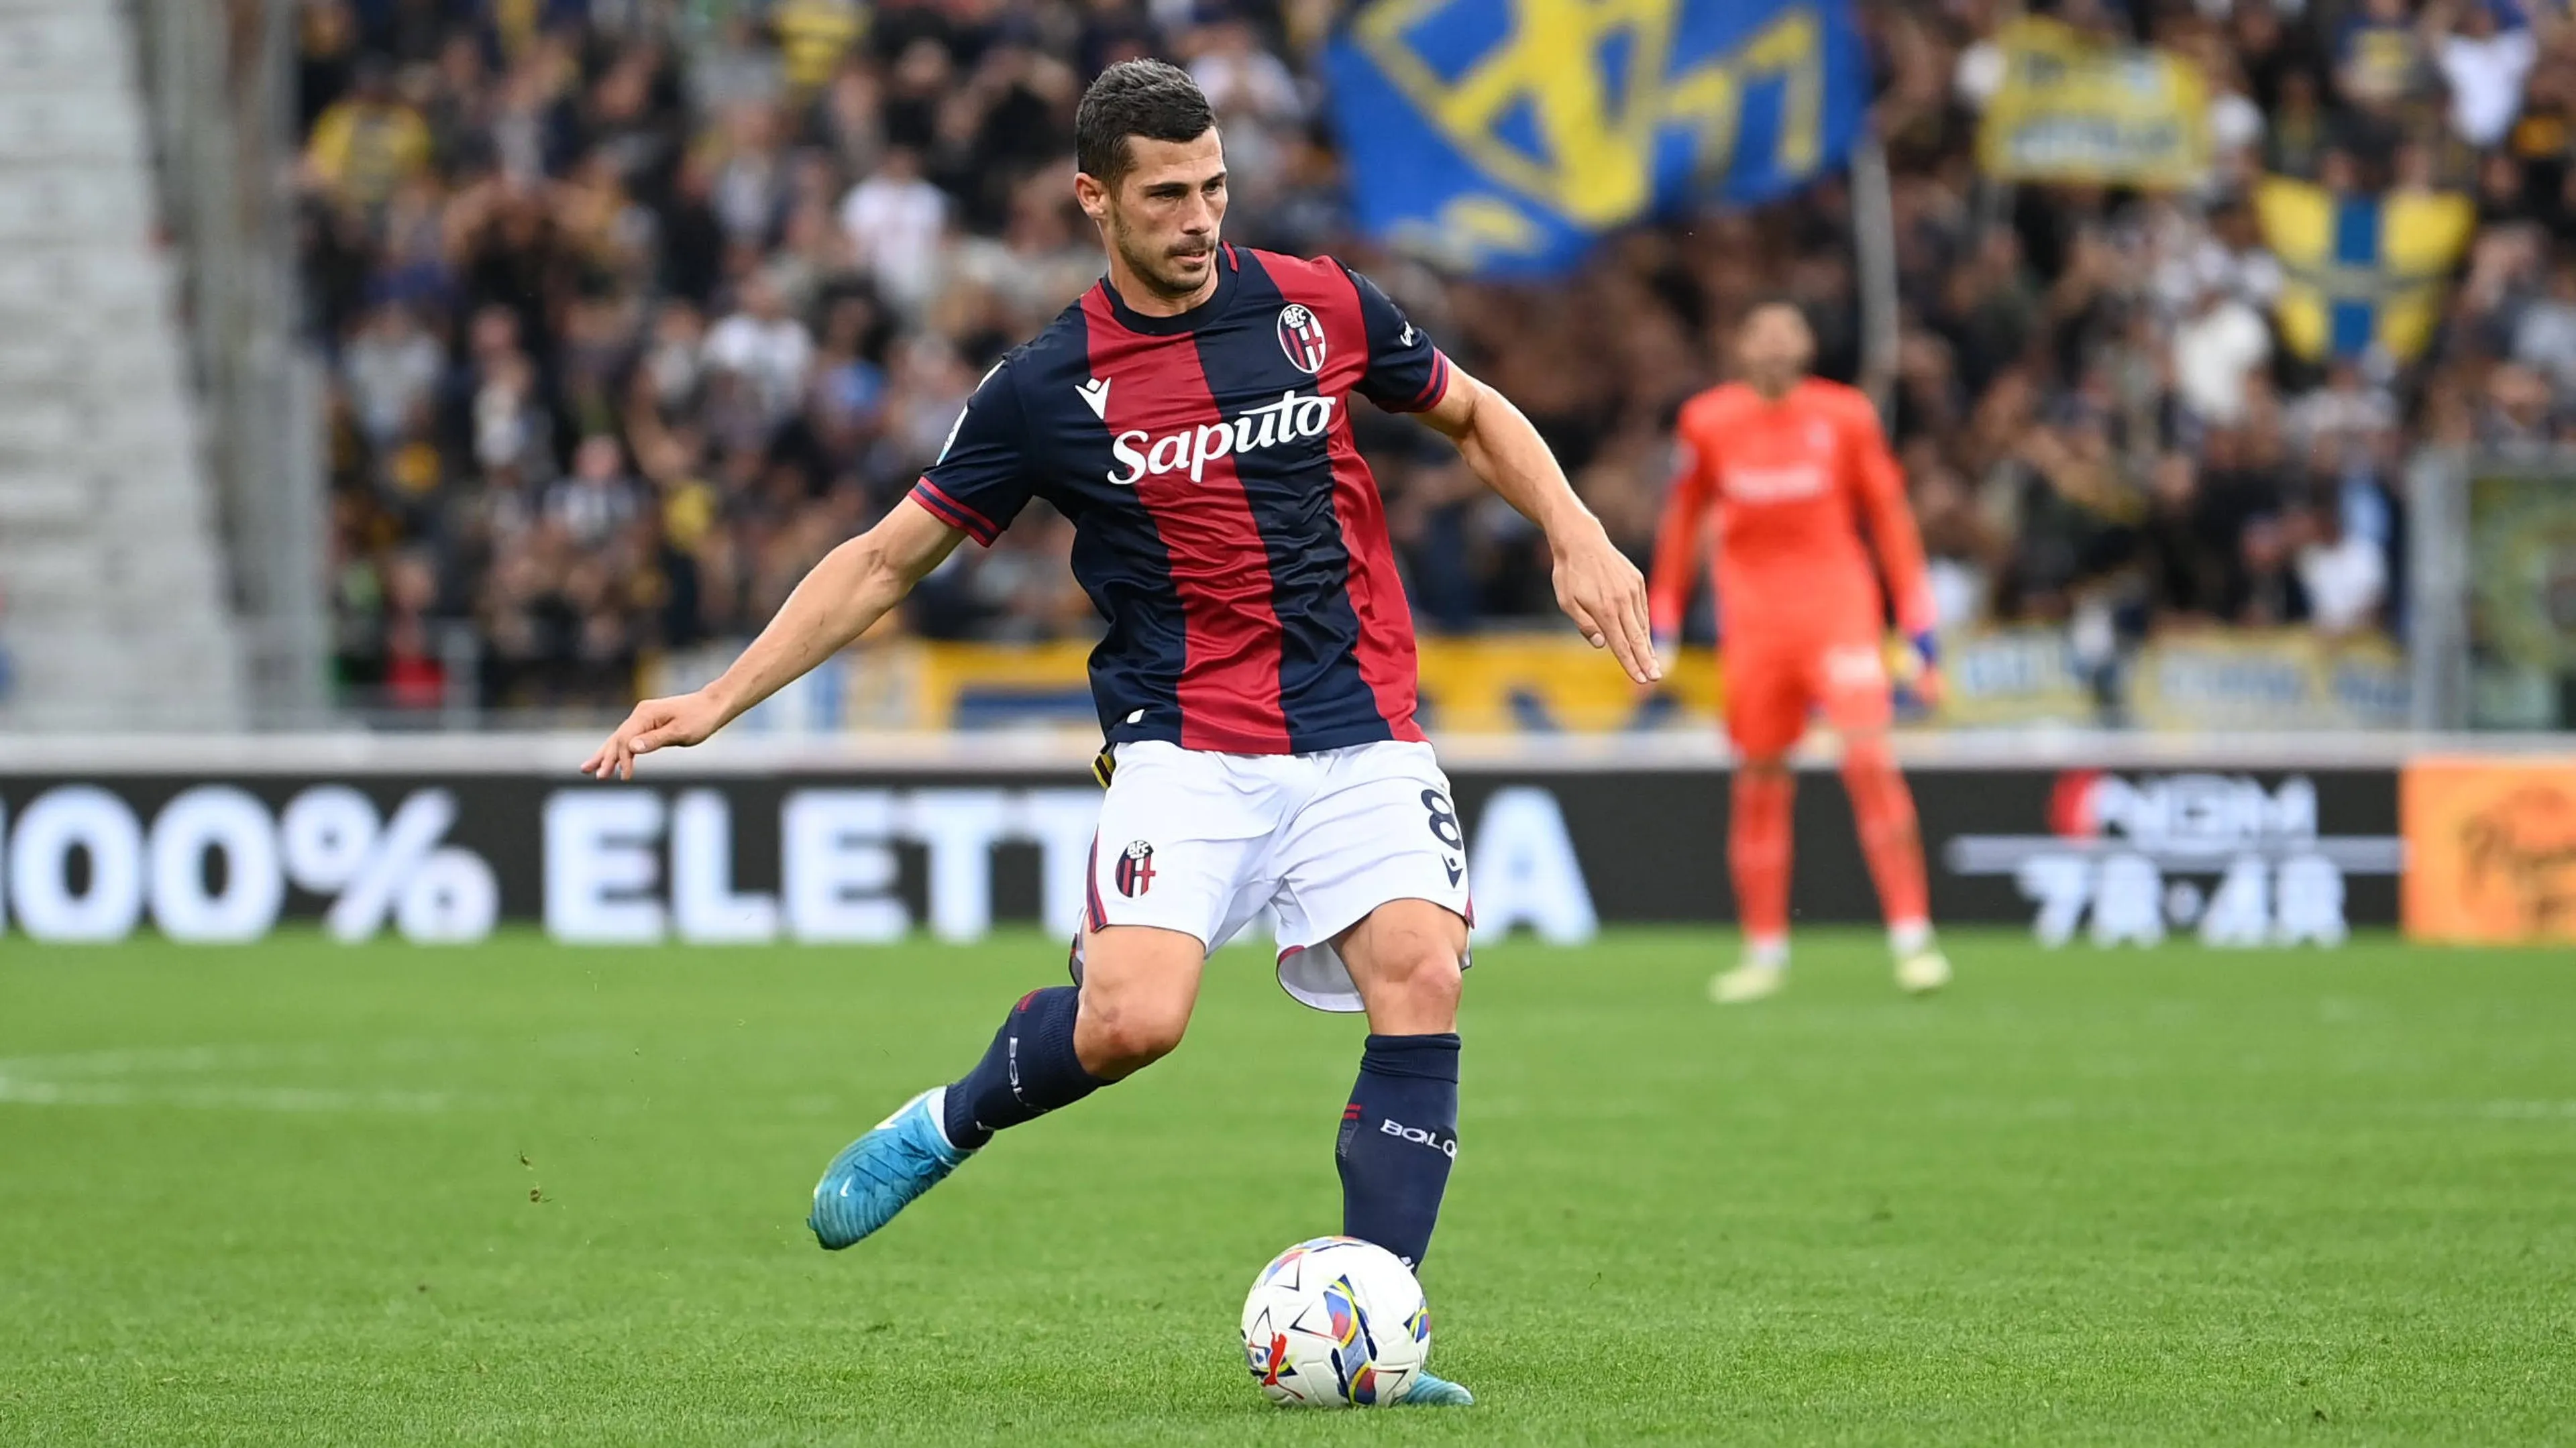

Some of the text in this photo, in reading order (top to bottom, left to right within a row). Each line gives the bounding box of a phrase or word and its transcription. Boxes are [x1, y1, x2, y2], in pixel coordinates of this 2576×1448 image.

[1283, 307, 1307, 325] BFC
[1107, 390, 1336, 484] Saputo
[1421, 789, 1462, 851] 8
[0, 785, 499, 946] 00%
